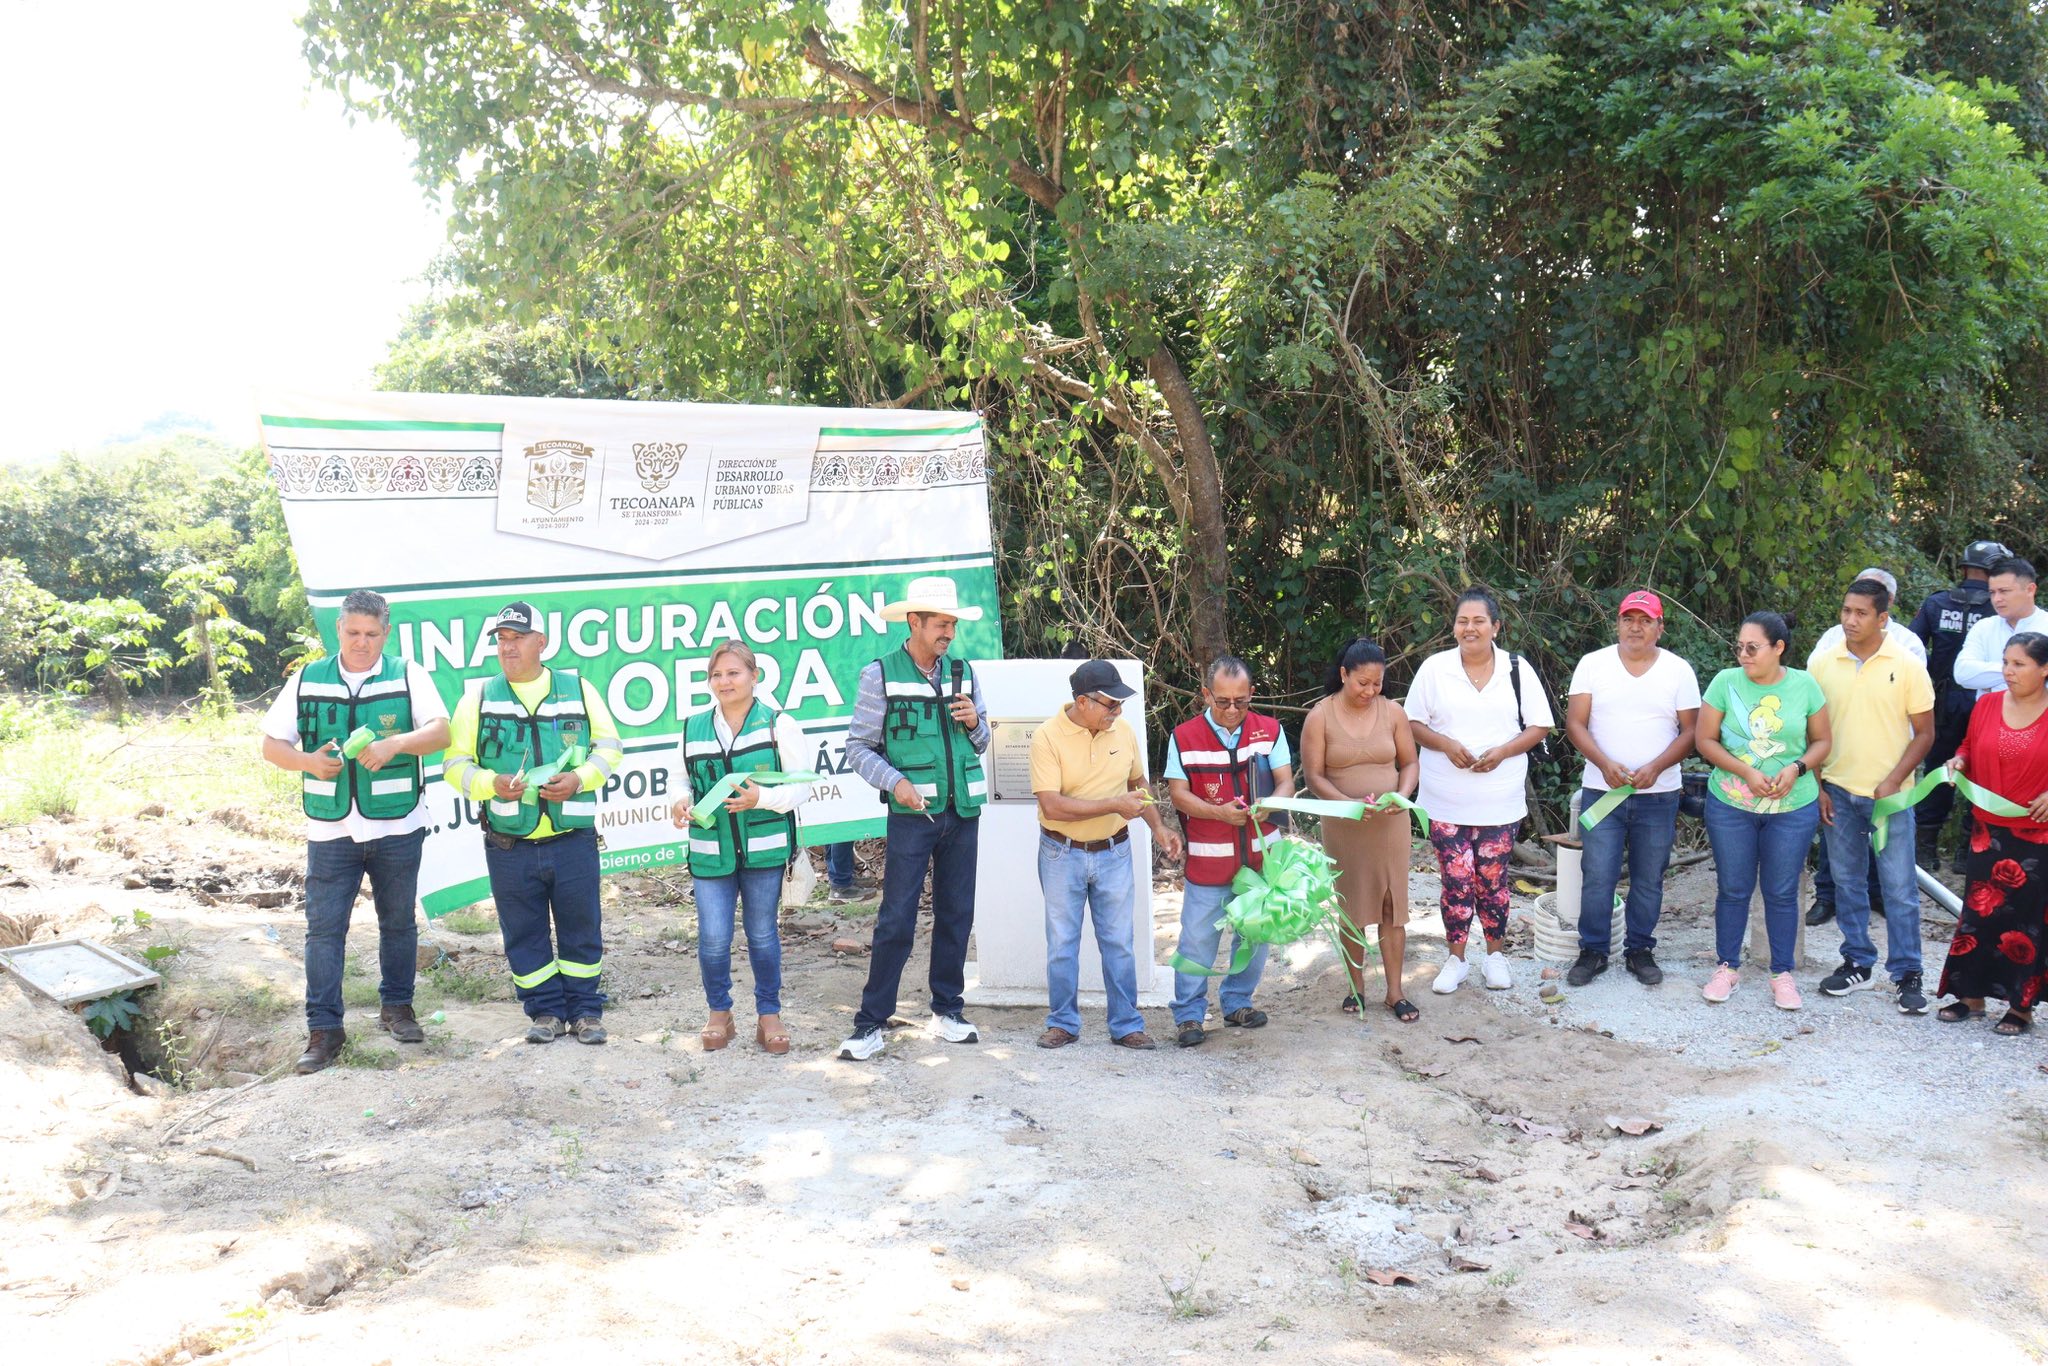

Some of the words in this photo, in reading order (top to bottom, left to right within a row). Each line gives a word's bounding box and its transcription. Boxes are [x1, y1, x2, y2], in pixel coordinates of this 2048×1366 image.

[538, 441, 582, 450] TECOANAPA
[718, 458, 765, 468] DIRECCIÓN
[765, 459, 777, 468] DE
[716, 470, 783, 482] DESARROLLO
[715, 485, 755, 495] URBANO
[757, 485, 764, 495] Y
[764, 484, 794, 495] OBRAS
[609, 496, 695, 509] TECOANAPA
[713, 496, 763, 510] PÚBLICAS
[631, 510, 682, 518] TRANSFORMA
[530, 516, 584, 524] AYUNTAMIENTO
[655, 847, 675, 862] de
